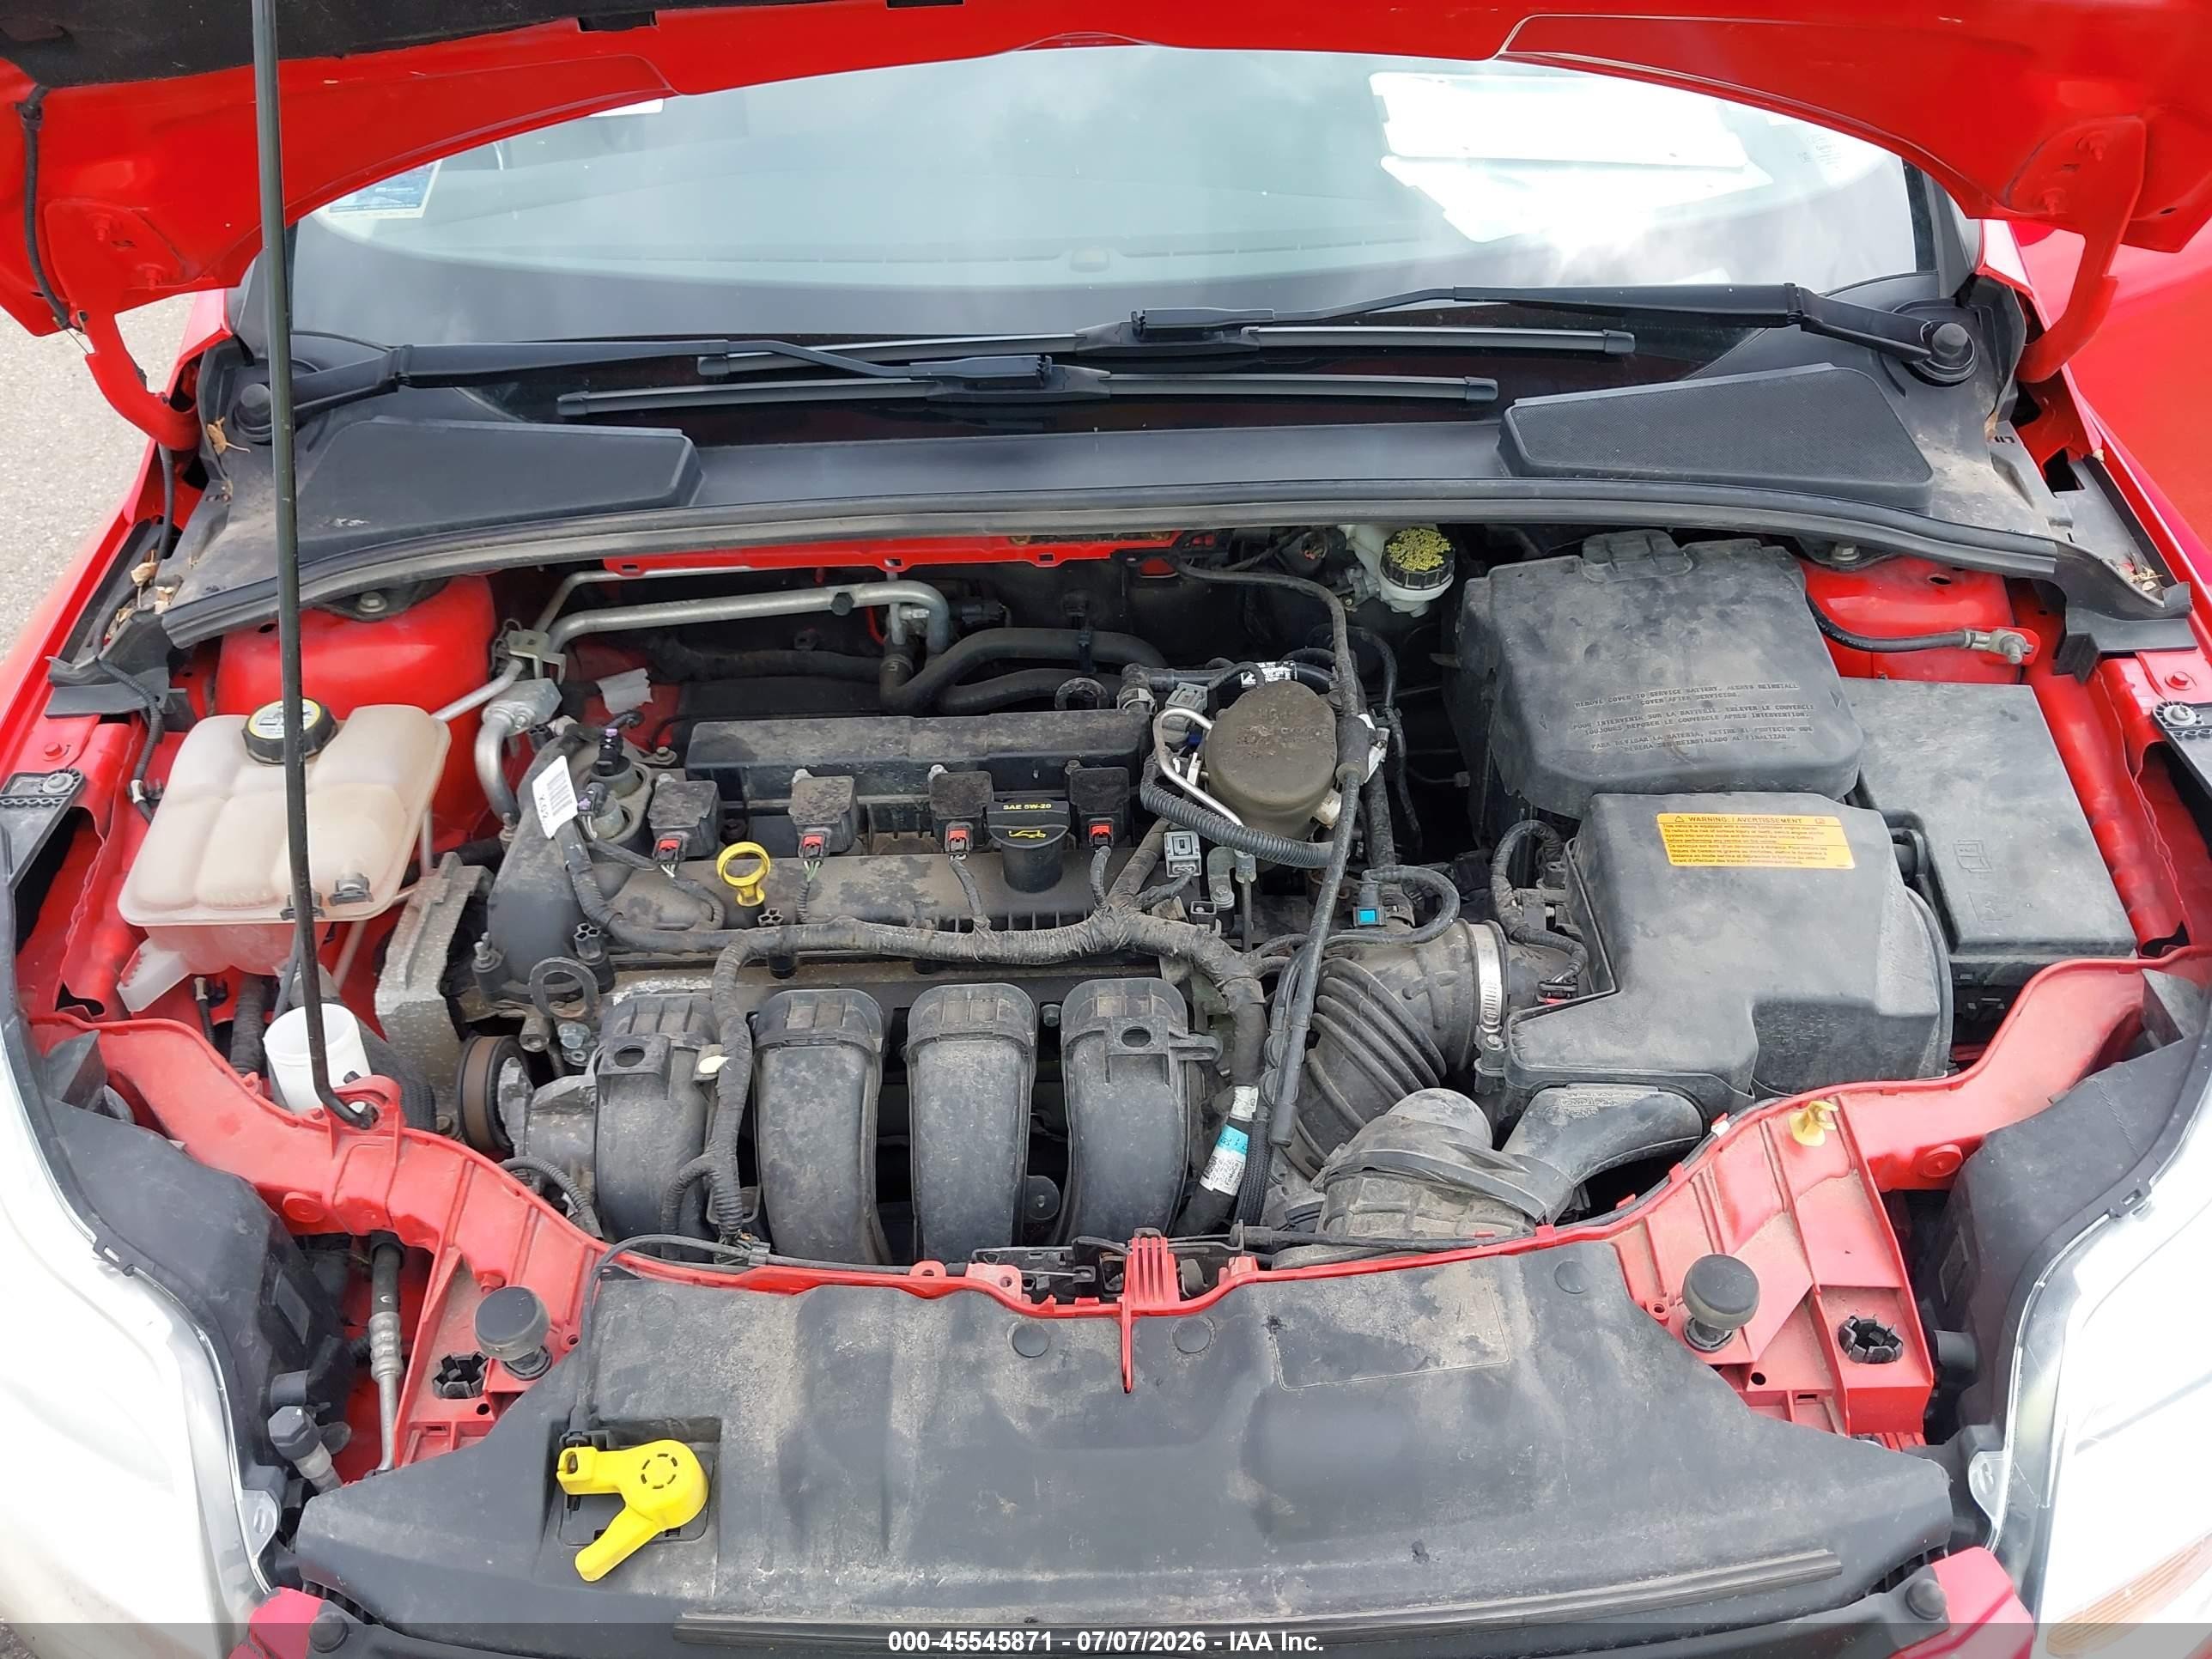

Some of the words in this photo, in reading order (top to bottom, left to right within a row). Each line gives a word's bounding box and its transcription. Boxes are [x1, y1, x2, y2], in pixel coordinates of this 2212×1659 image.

[1608, 695, 1632, 703] COVER
[1626, 720, 1660, 729] REPOSER
[1225, 1162, 1240, 1186] FoMoCo
